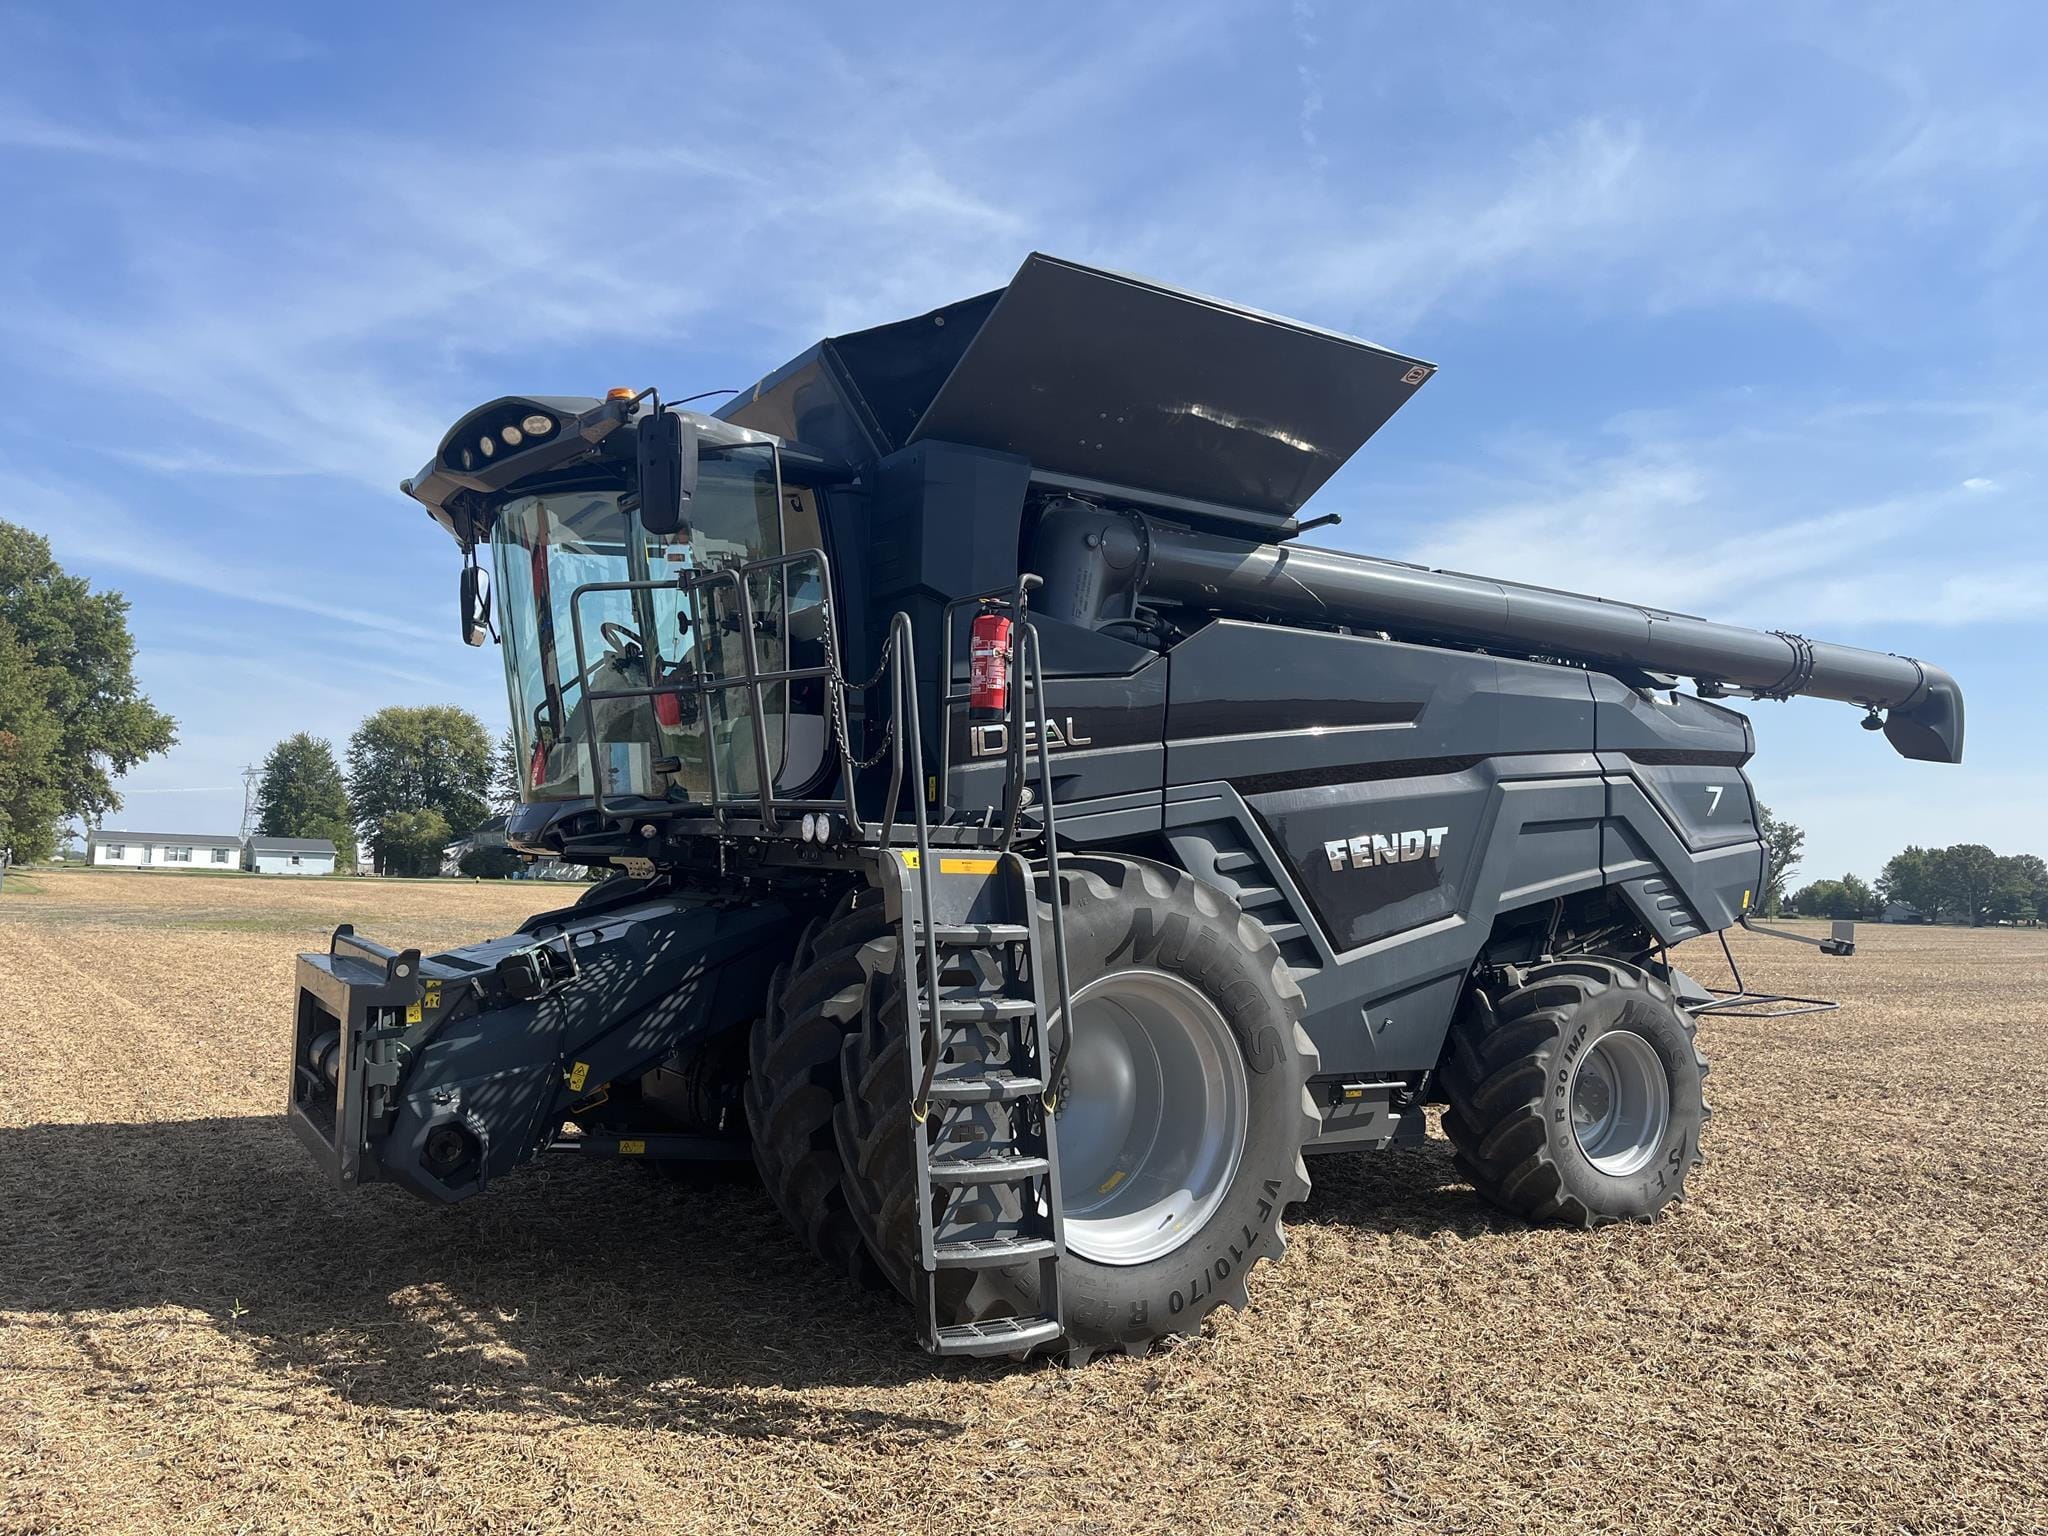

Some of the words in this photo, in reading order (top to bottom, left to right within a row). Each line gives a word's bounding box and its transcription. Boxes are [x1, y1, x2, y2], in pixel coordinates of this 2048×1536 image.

[970, 716, 1092, 757] IDEAL
[1705, 785, 1724, 817] 7
[1323, 826, 1449, 872] FENDT
[1105, 908, 1287, 1074] Mitas
[1564, 1024, 1588, 1064] IMP
[1556, 1069, 1569, 1098] 30
[1555, 1108, 1565, 1123] R
[1255, 1178, 1282, 1224] VF
[1168, 1223, 1259, 1315] 710/70
[1127, 1298, 1149, 1329] R
